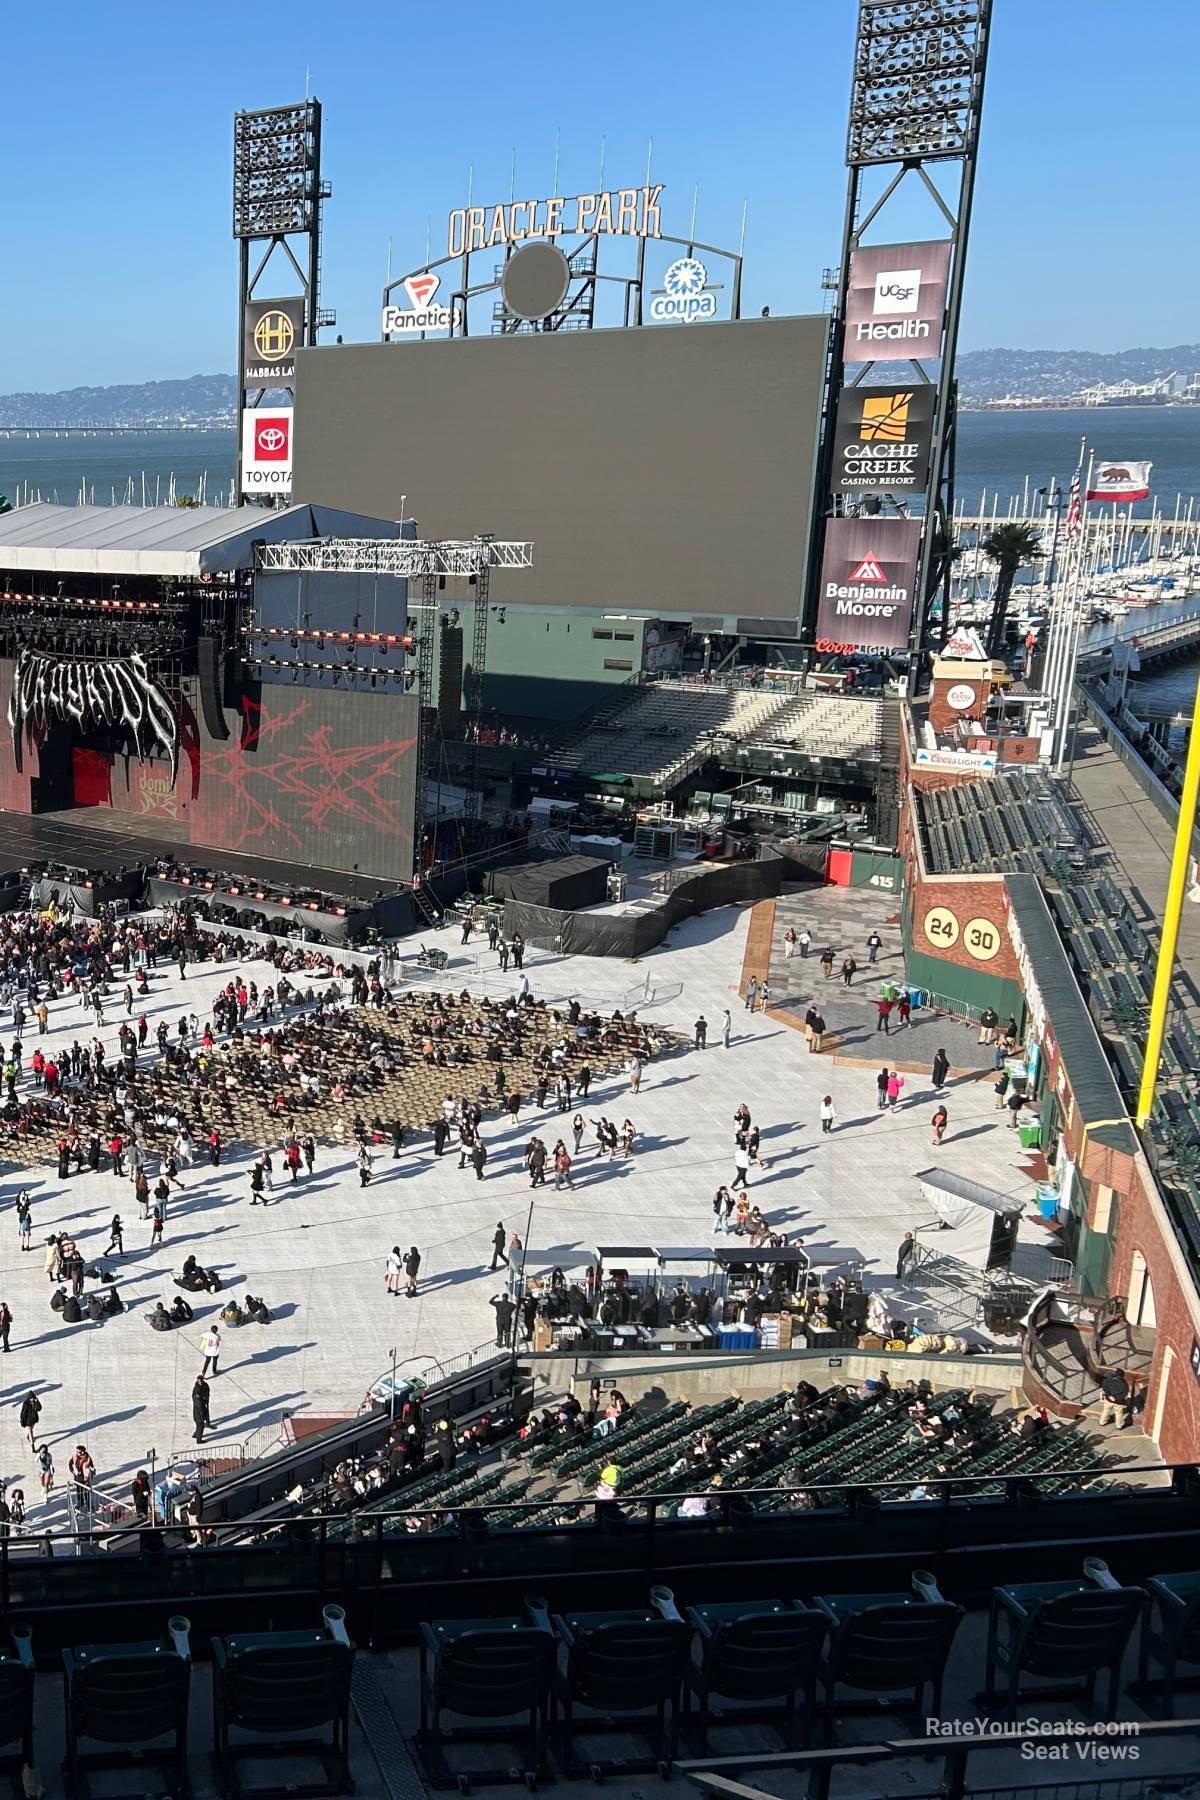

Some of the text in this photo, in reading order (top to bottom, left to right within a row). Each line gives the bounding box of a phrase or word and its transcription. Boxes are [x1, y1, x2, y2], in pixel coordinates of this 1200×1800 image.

[448, 184, 666, 258] ORACLE PARK
[880, 284, 914, 301] UCSF
[653, 293, 714, 321] coupa
[385, 309, 458, 329] Fanatics
[856, 319, 930, 341] Health
[246, 366, 281, 378] HABBAS
[843, 443, 919, 459] CACHE
[844, 460, 914, 474] CREEK
[246, 471, 293, 483] TOYOTA
[841, 476, 916, 486] CASINO RESORT
[826, 582, 907, 601] Benjamin
[815, 637, 894, 656] Coors LIGHT
[869, 875, 894, 888] 415
[930, 917, 953, 938] 24
[970, 929, 993, 950] 30
